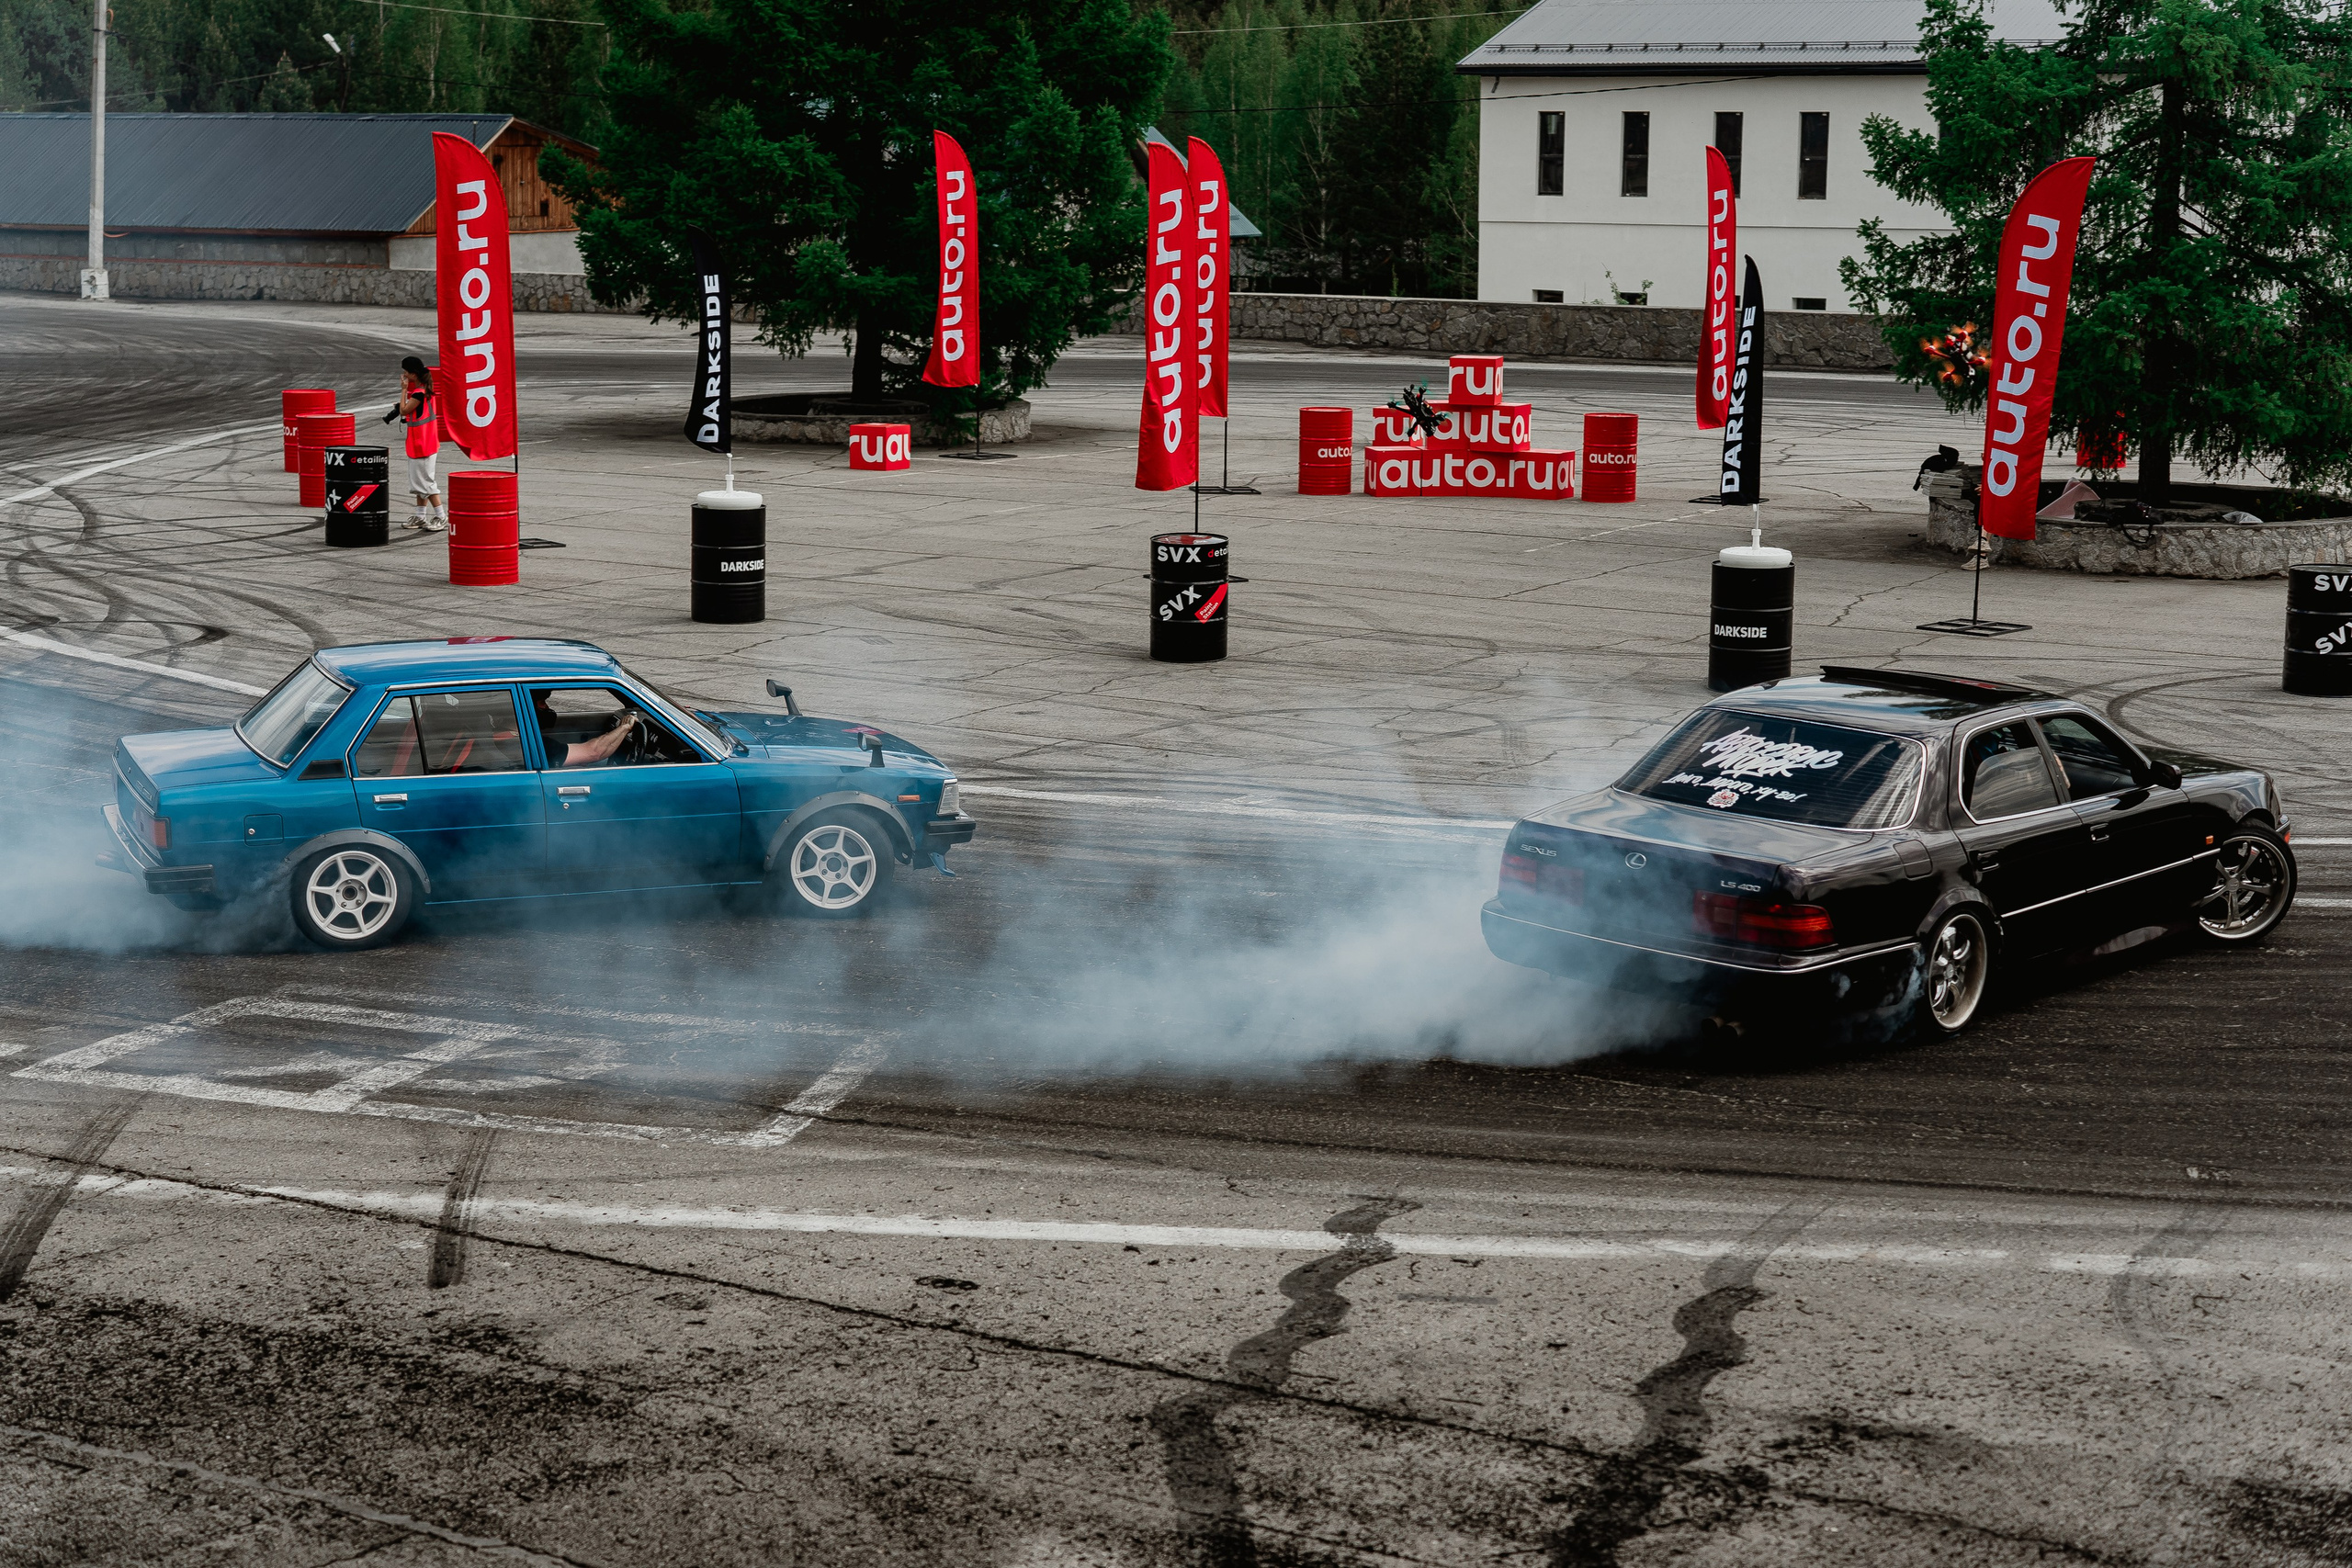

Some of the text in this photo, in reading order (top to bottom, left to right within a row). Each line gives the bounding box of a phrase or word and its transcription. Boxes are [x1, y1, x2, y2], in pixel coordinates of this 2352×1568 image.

[943, 170, 965, 362] auto.ru
[456, 179, 498, 428] auto.ru
[1712, 188, 1728, 401] auto.ru
[1149, 188, 1183, 454] auto.ru
[696, 274, 720, 443] DARKSIDE
[1987, 213, 2061, 497] auto.ru
[1721, 305, 1757, 494] DARKSIDE
[324, 451, 345, 467] VX
[1379, 454, 1553, 491] auto.ru
[1589, 452, 1637, 465] auto.ru
[324, 489, 342, 520] VX
[720, 558, 764, 572] DARKSIDE
[1158, 546, 1202, 563] SVX
[2313, 574, 2352, 592] SV
[1159, 584, 1202, 621] SVX
[1199, 602, 1214, 616] Paint
[1202, 602, 1219, 620] Station
[1713, 624, 1768, 638] DARKSIDE
[1720, 880, 1761, 892] LS 400
